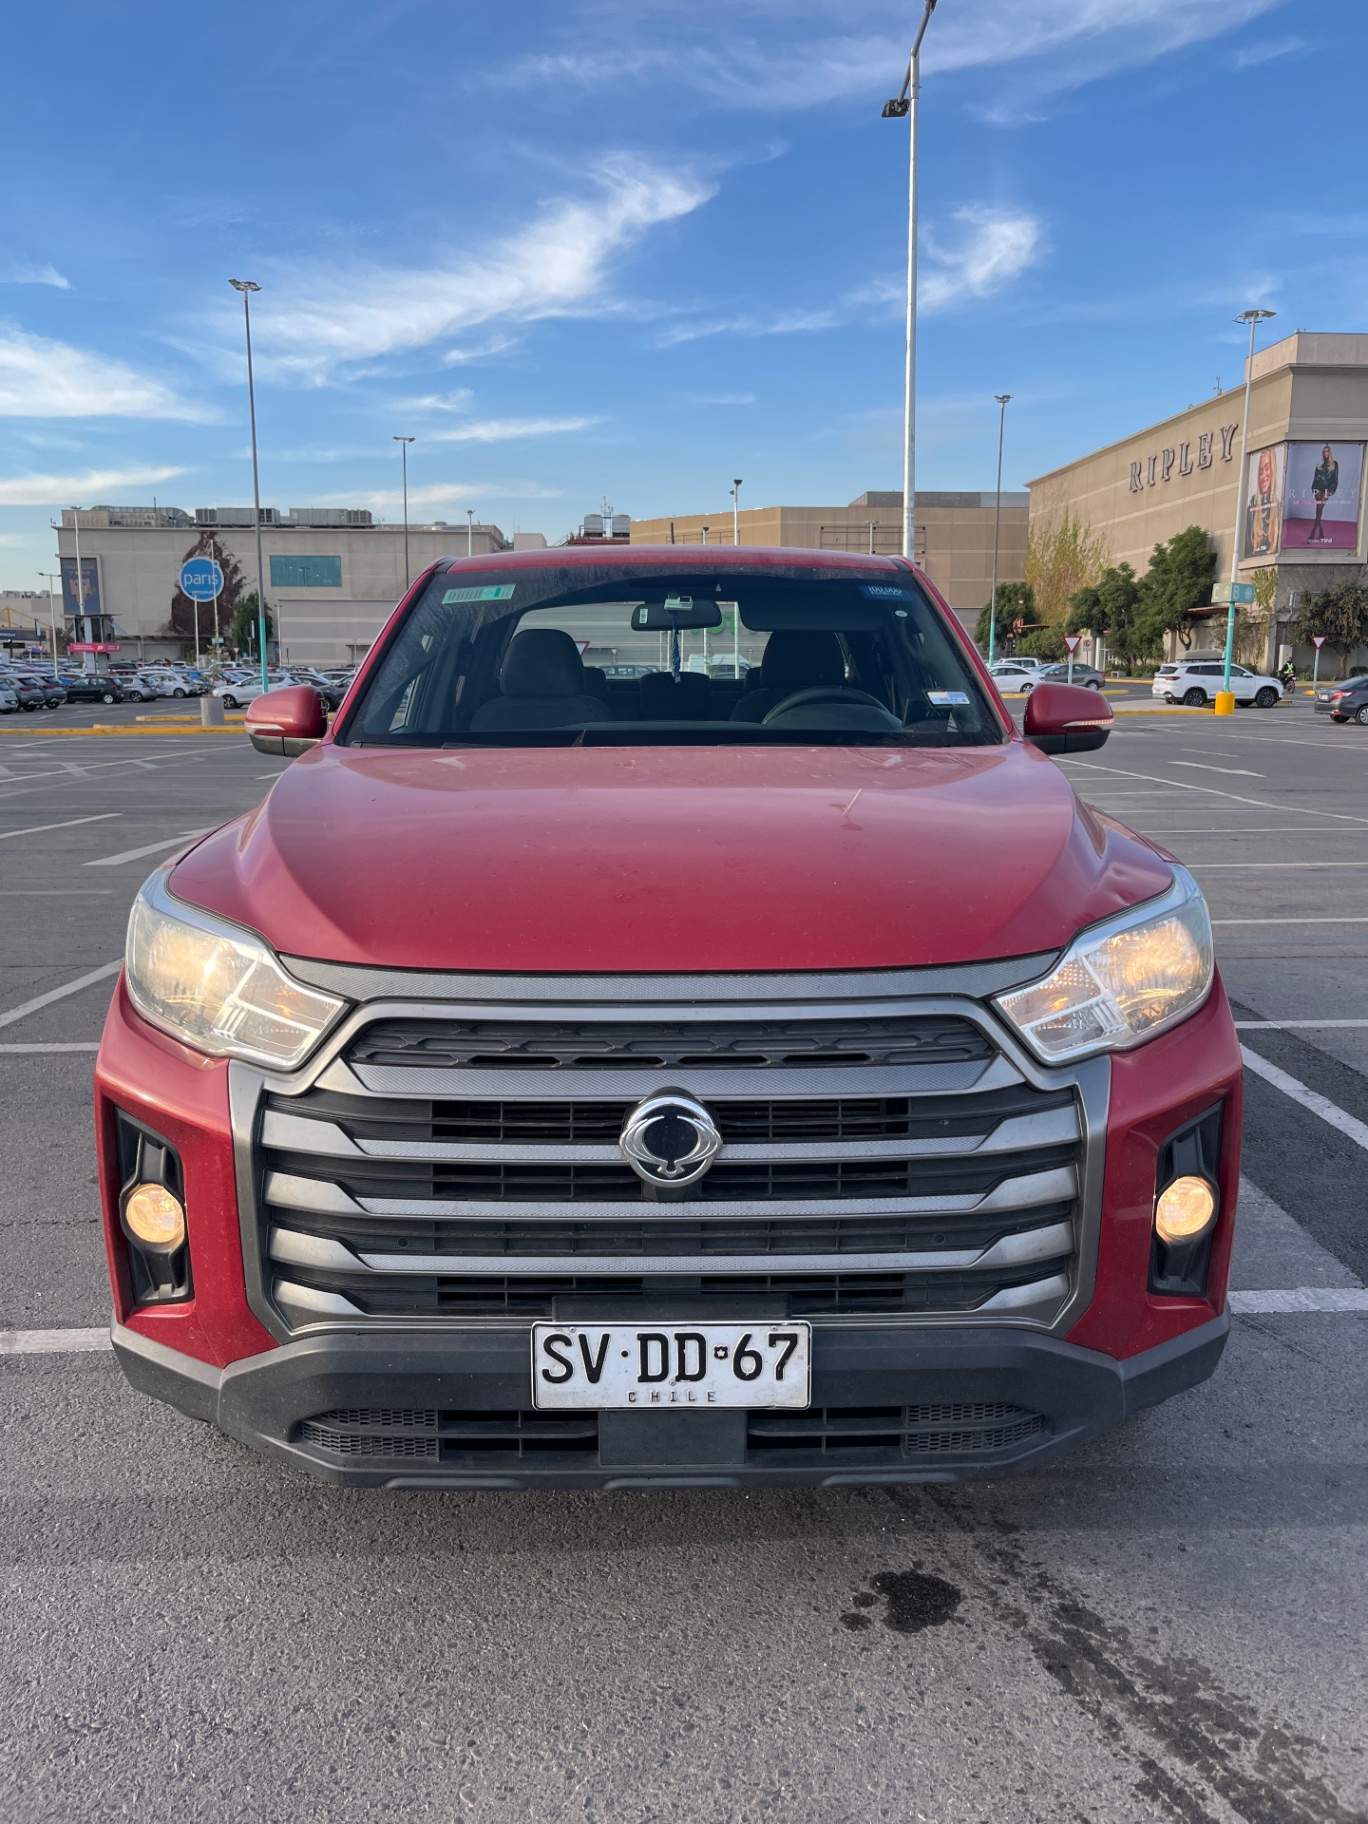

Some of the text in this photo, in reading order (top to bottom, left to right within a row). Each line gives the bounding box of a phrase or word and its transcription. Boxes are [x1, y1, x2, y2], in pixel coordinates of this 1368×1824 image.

[1129, 423, 1239, 493] RIPLEY
[183, 573, 219, 588] paris
[628, 1391, 717, 1403] CHILE
